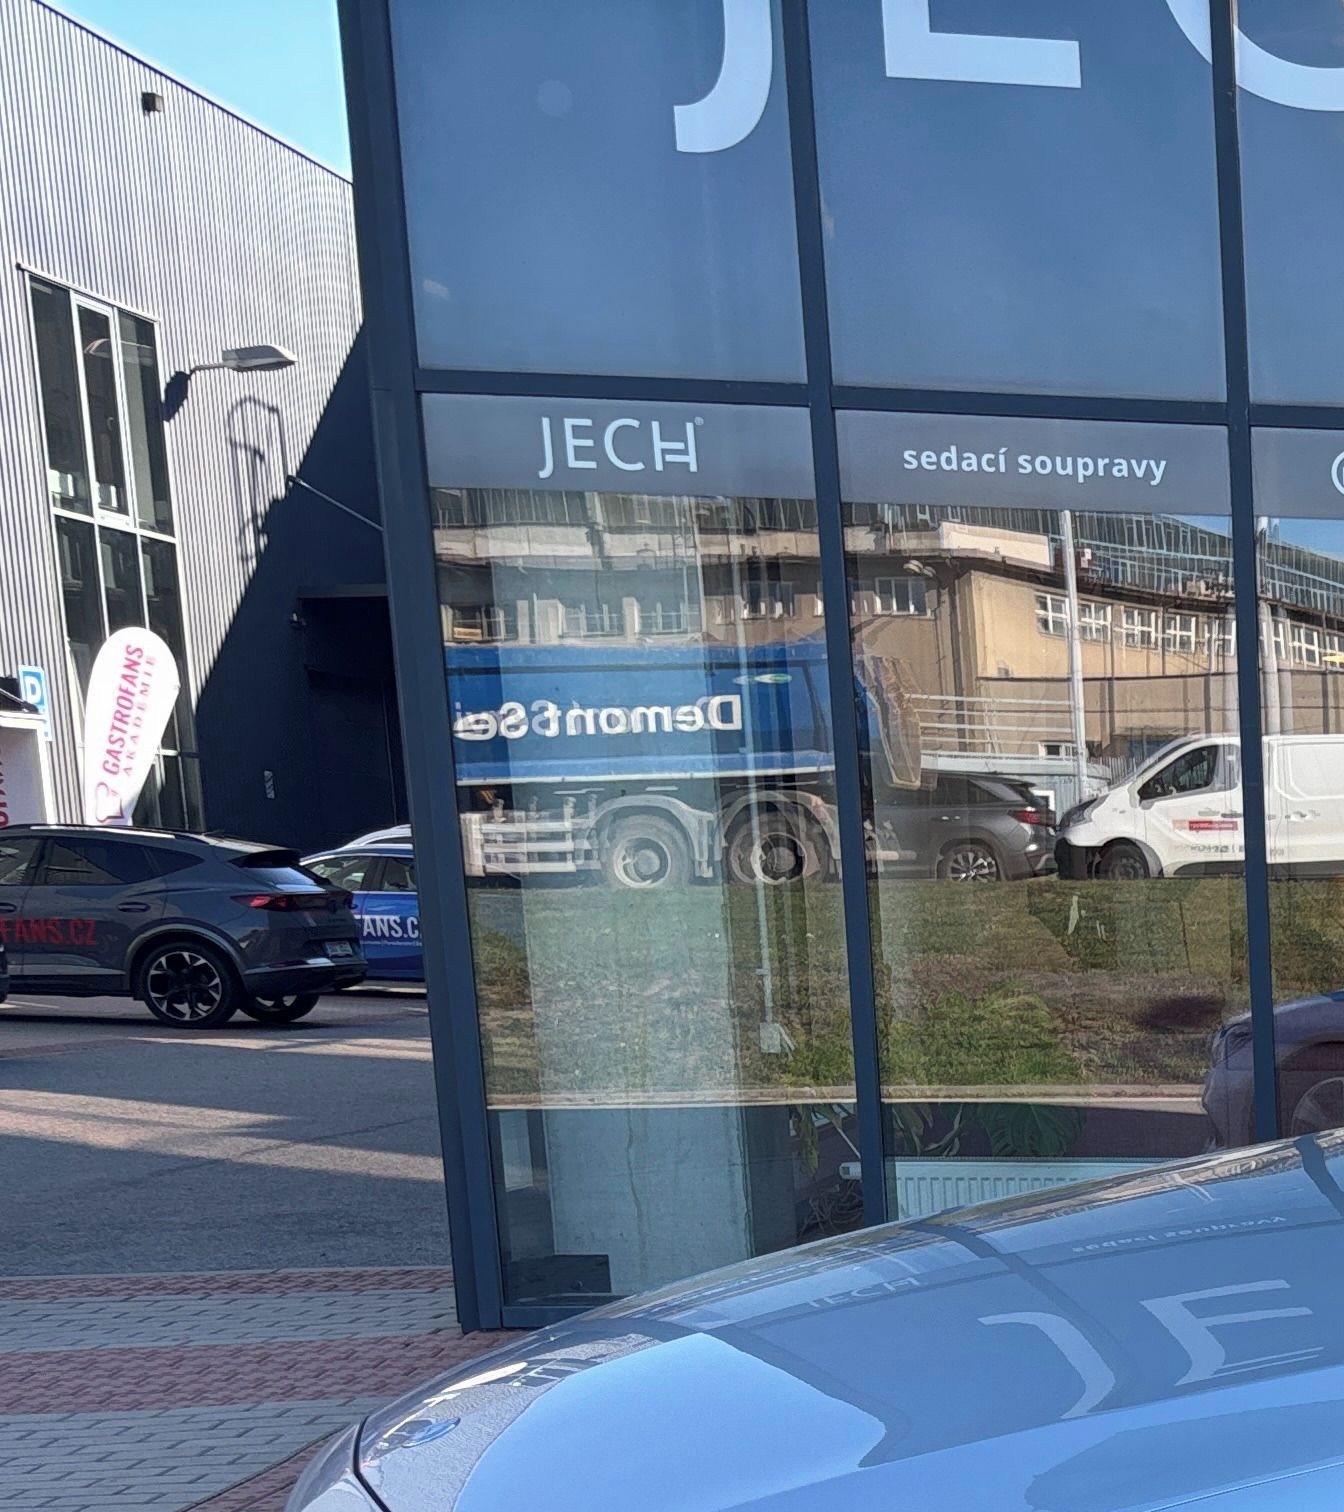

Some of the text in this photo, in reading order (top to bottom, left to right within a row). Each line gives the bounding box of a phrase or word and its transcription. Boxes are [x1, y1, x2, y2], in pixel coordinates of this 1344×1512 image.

[538, 416, 698, 479] JECH
[903, 445, 1167, 486] sedací soupravy
[102, 644, 144, 776] GASTROFANS
[354, 914, 422, 939] ANS.C
